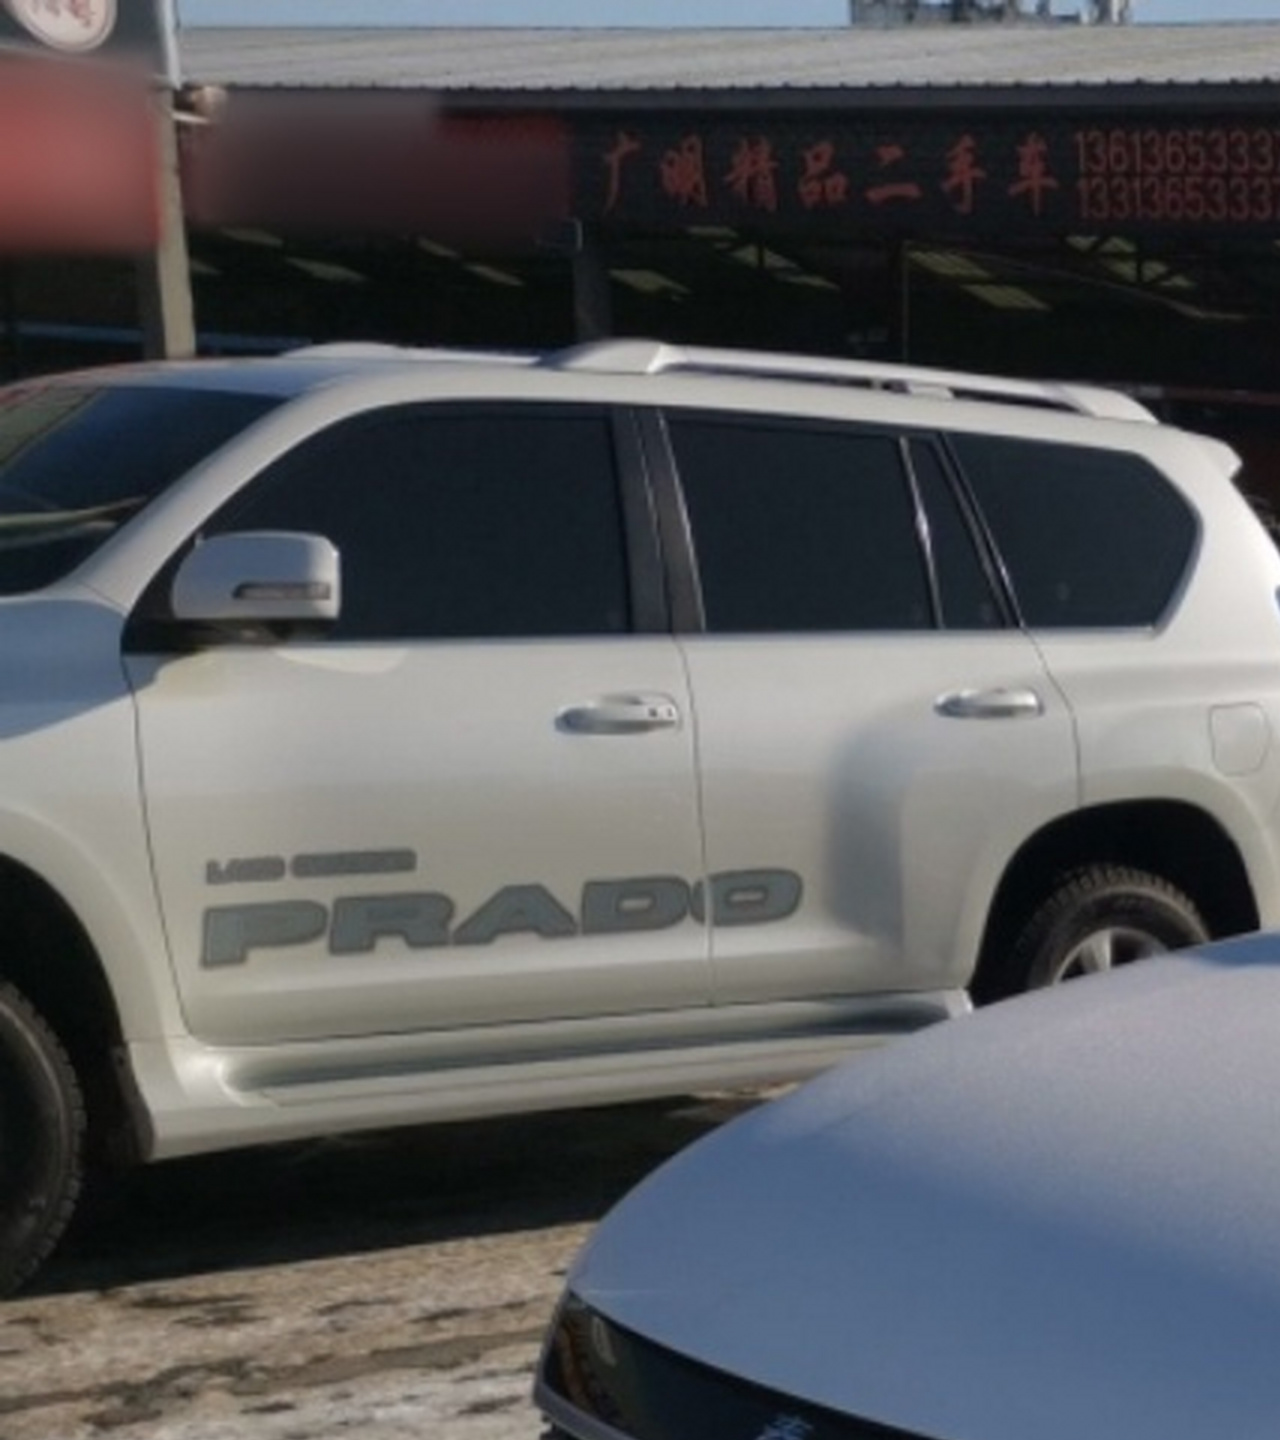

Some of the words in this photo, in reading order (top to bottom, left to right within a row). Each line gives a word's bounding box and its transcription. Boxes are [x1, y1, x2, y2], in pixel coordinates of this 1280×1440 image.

[602, 129, 1060, 217] 广明精品二手车
[200, 867, 803, 969] PRADO
